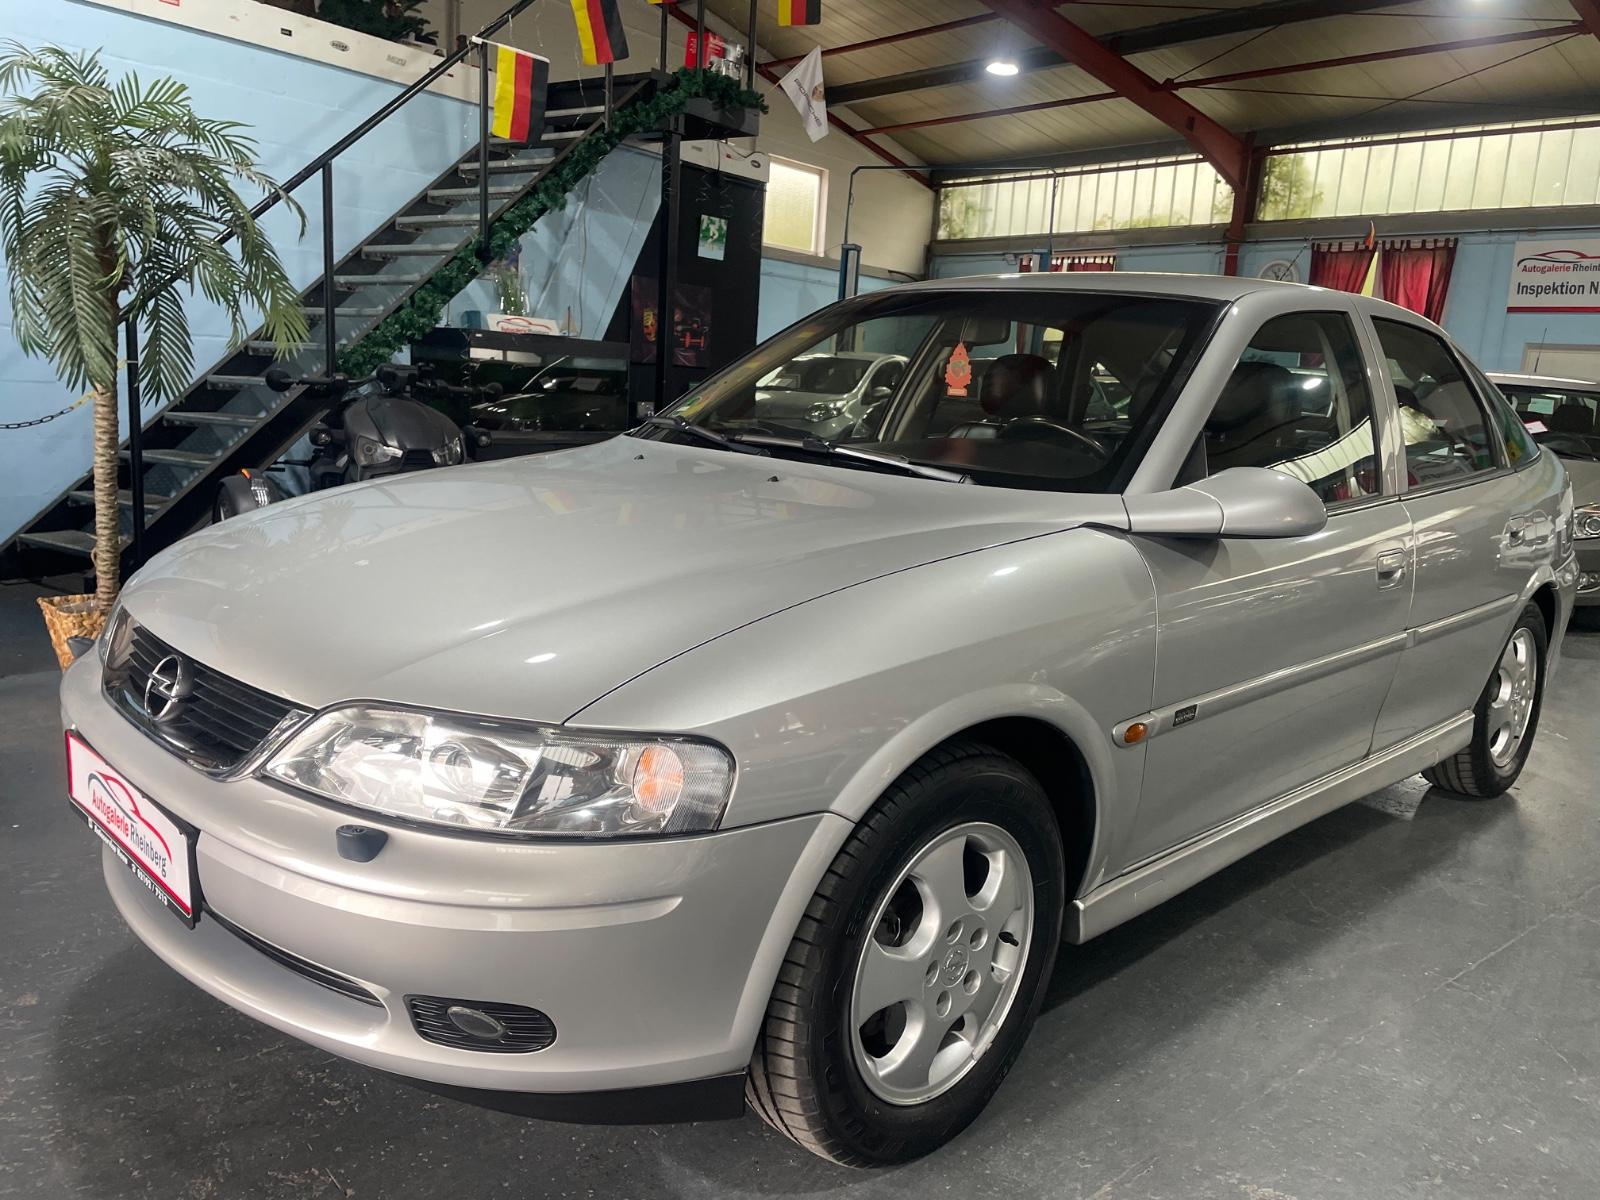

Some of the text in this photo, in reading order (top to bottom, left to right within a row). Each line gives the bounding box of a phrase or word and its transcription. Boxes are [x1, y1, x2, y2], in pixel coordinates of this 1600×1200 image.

[1522, 264, 1571, 274] Autogalerie
[1516, 281, 1585, 298] Inspektion
[92, 789, 129, 837] Autogalerie
[130, 823, 167, 878] Rheinberg
